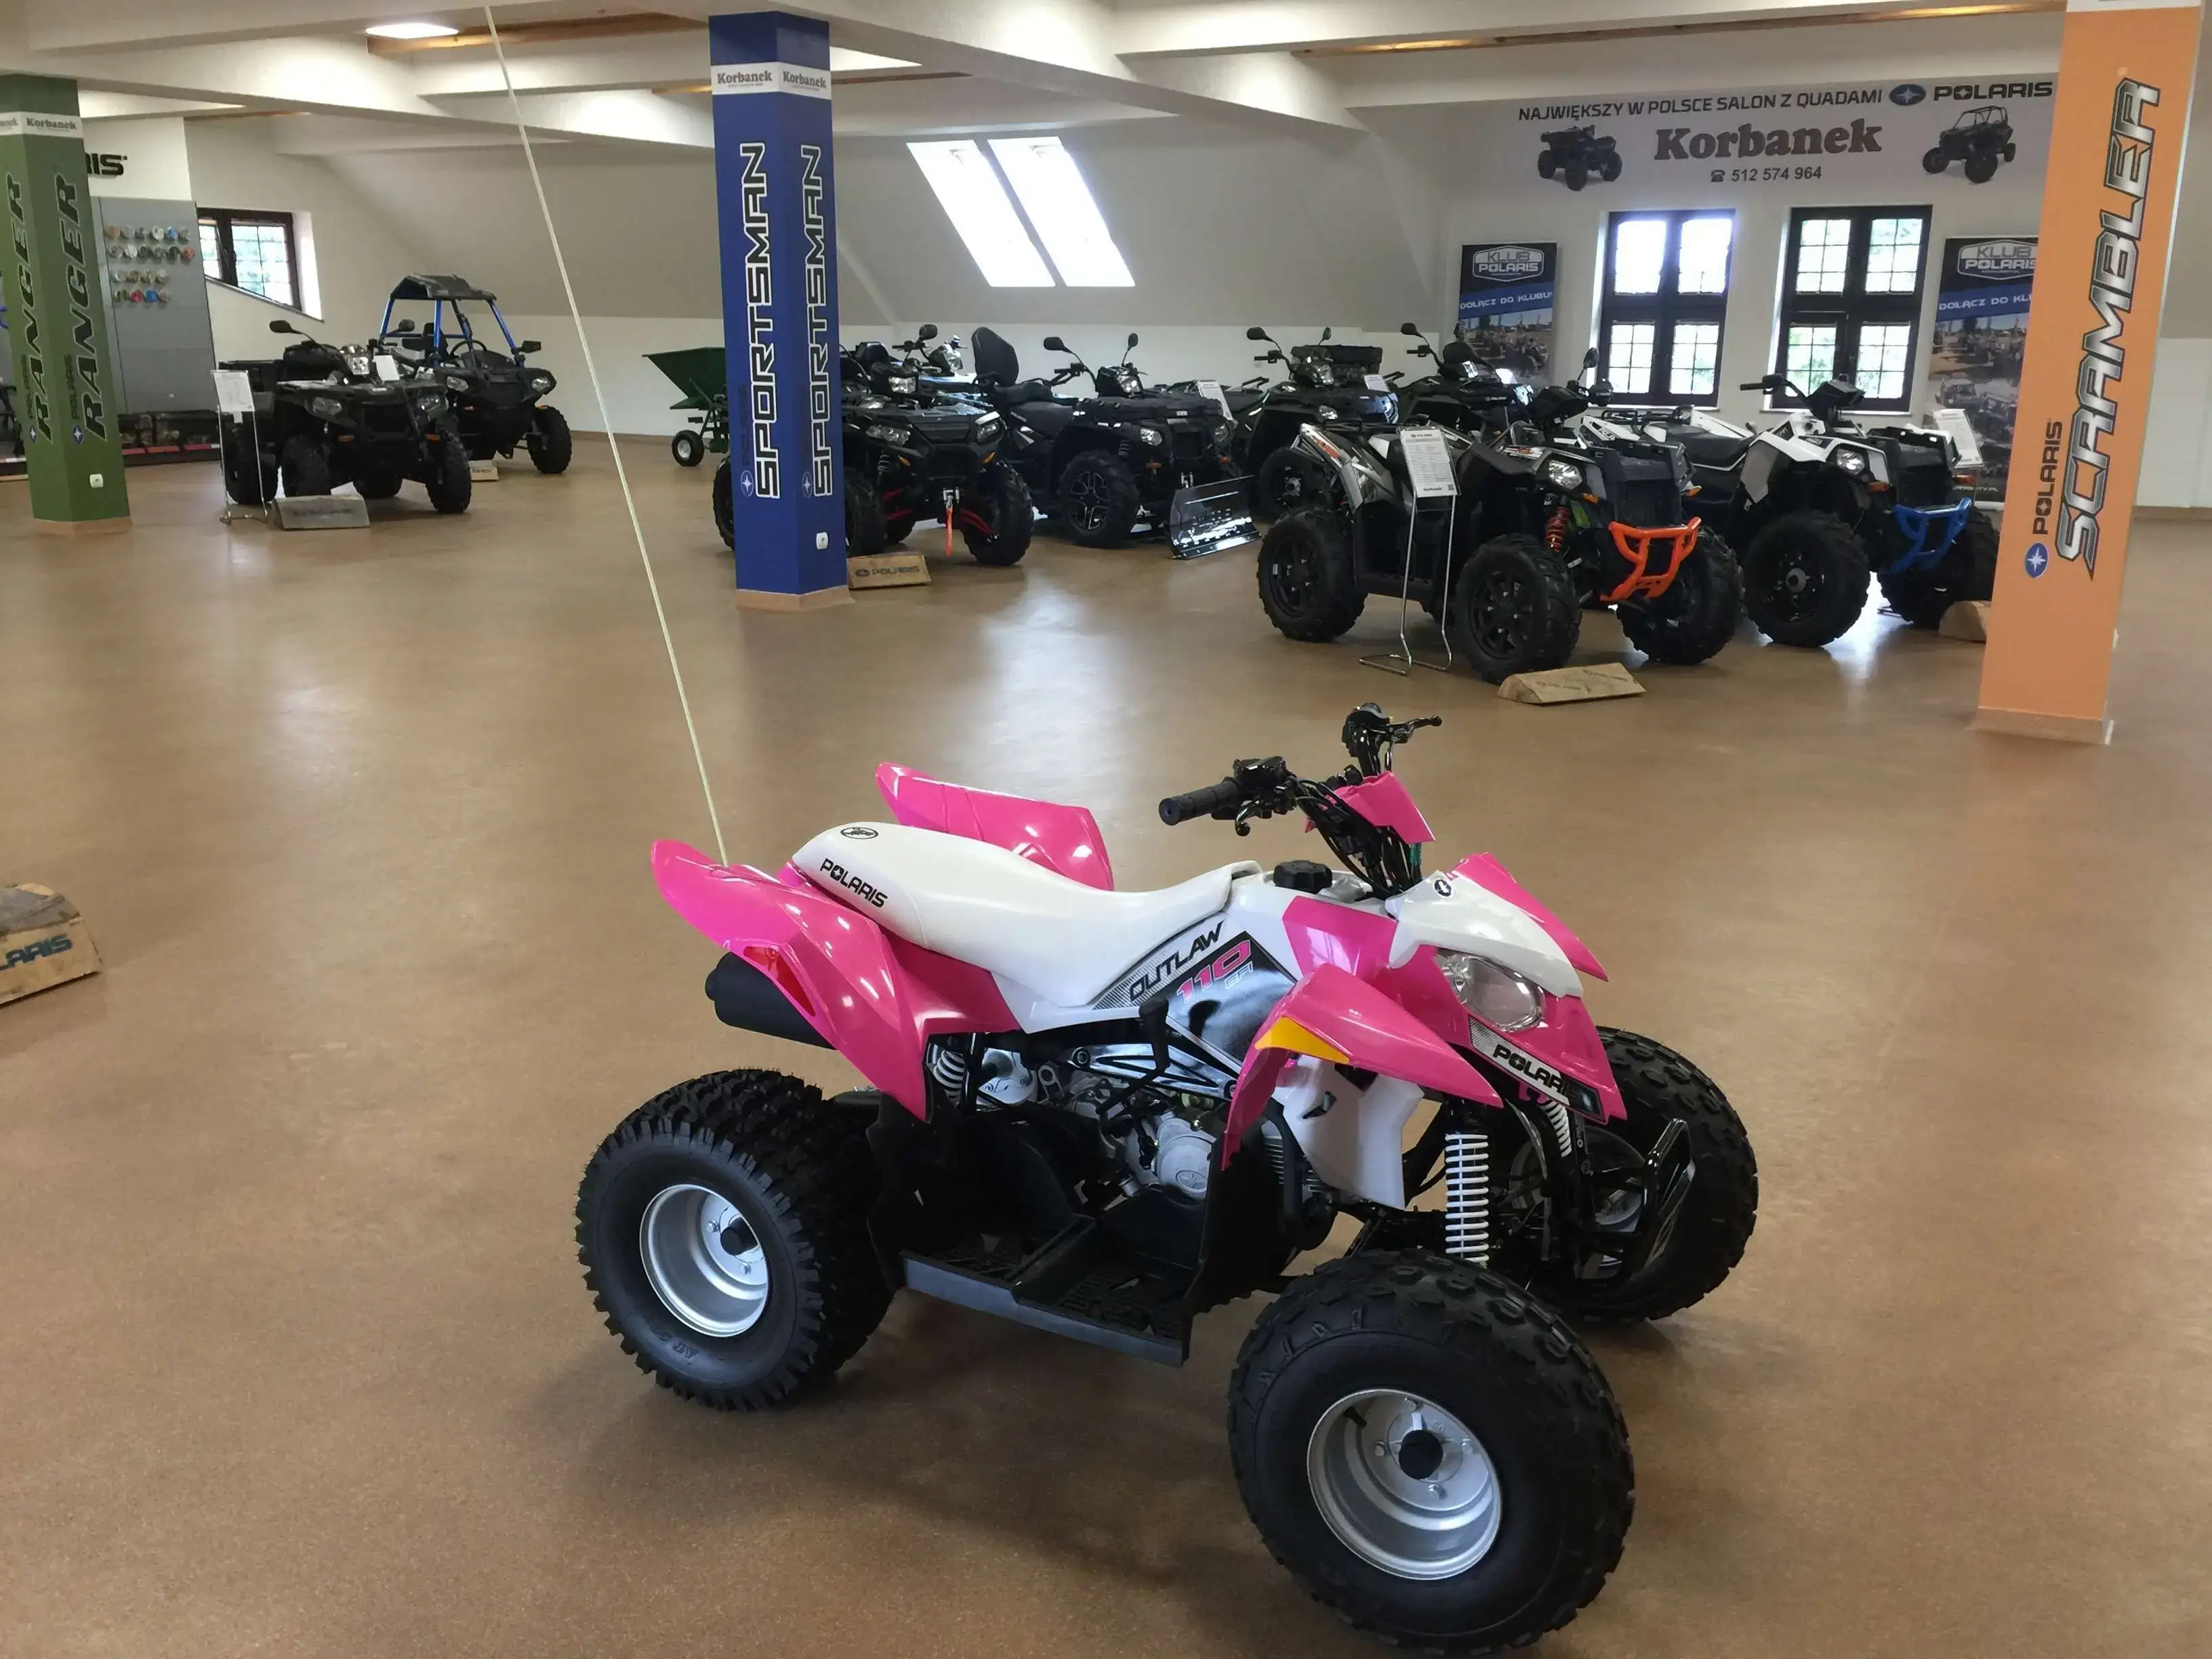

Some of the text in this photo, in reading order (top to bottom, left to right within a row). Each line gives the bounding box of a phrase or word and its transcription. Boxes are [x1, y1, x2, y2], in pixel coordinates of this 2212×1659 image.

[717, 70, 773, 85] Korbanek
[783, 70, 827, 89] Korbanek
[1518, 81, 2053, 121] NAJWIĘKSZY W POLSCE SALON Z QUADAMI POLARIS
[26, 118, 77, 130] Korbanek
[1654, 118, 1883, 161] Korbanek
[1732, 167, 1822, 182] 512 574 964
[1479, 262, 1539, 272] POLARIS
[1488, 251, 1530, 262] KLUB
[1976, 246, 2032, 258] KLUB
[5, 171, 54, 445] RANGER
[54, 171, 108, 443] RANGER
[1500, 296, 1514, 304] DO
[1991, 297, 2009, 305] DO
[739, 142, 780, 499] SPORTSMAN
[800, 144, 833, 497] SPORTSMAN
[2055, 77, 2160, 581] SCRAMBLER
[2032, 420, 2063, 535] POLARIS
[819, 858, 888, 908] POLARIS
[1130, 919, 1225, 1002] OUTLAW
[1176, 939, 1252, 1004] 110
[1224, 961, 1254, 989] EFI
